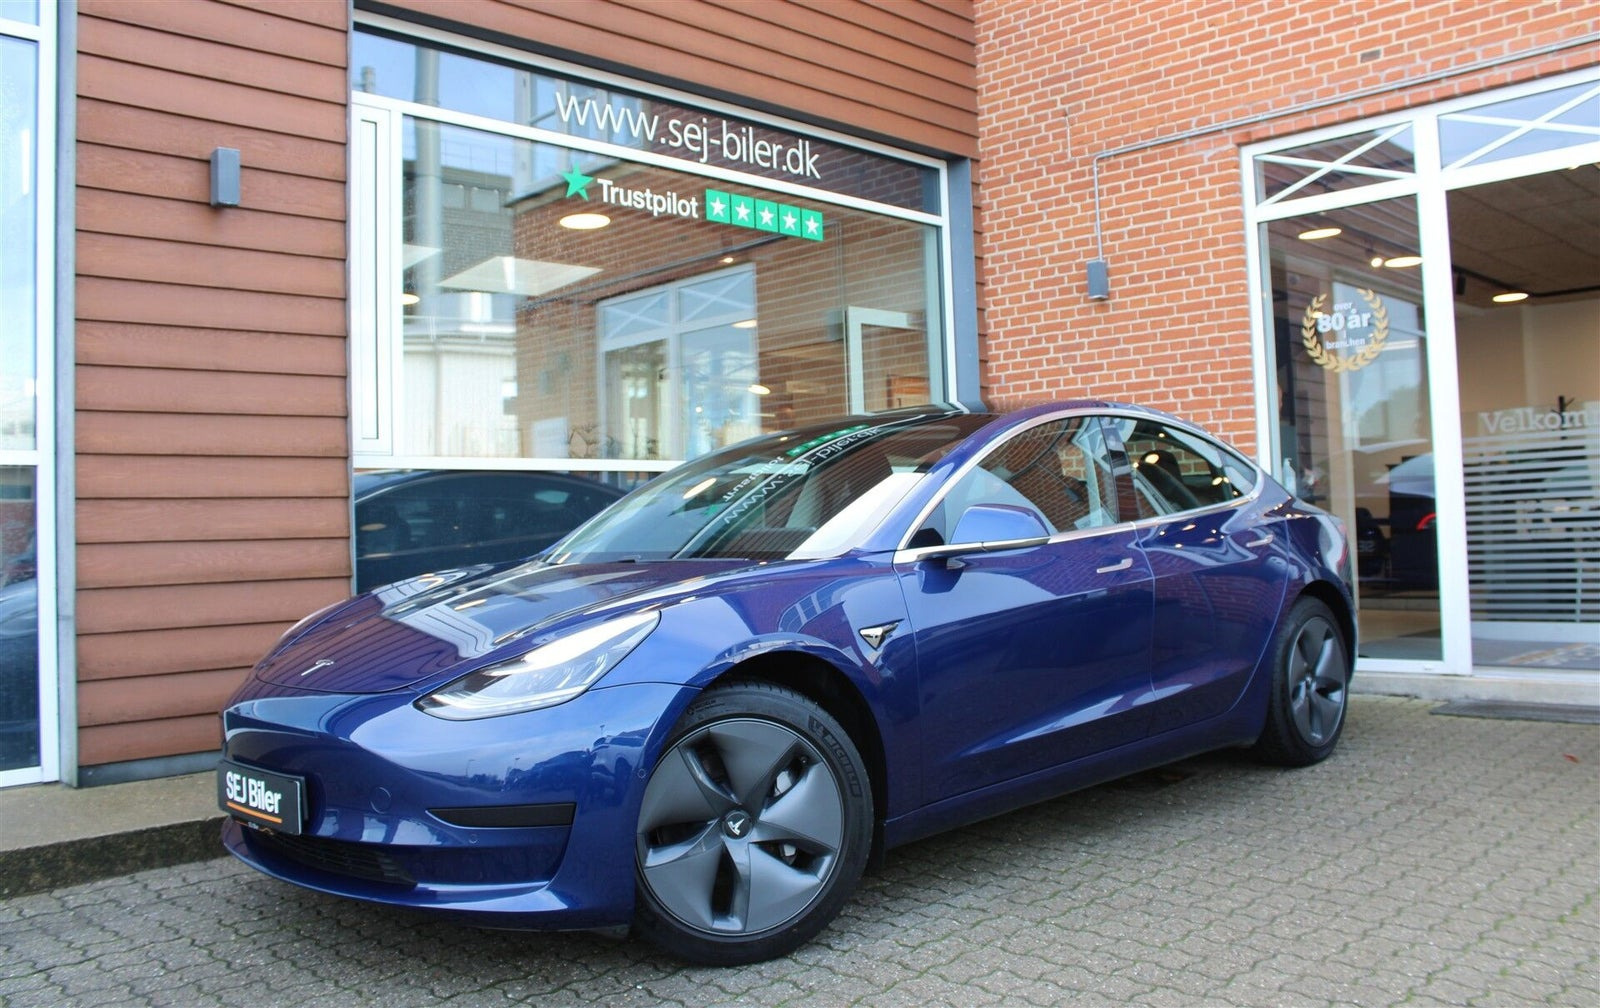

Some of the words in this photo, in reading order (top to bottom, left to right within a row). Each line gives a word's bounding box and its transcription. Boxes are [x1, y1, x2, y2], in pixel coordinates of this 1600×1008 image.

[556, 92, 821, 179] www.sej-biler.dk
[597, 178, 699, 219] Trustpilot
[1317, 312, 1345, 333] 80
[1347, 308, 1371, 328] år
[226, 771, 247, 804] SEJ
[248, 778, 282, 814] Biler
